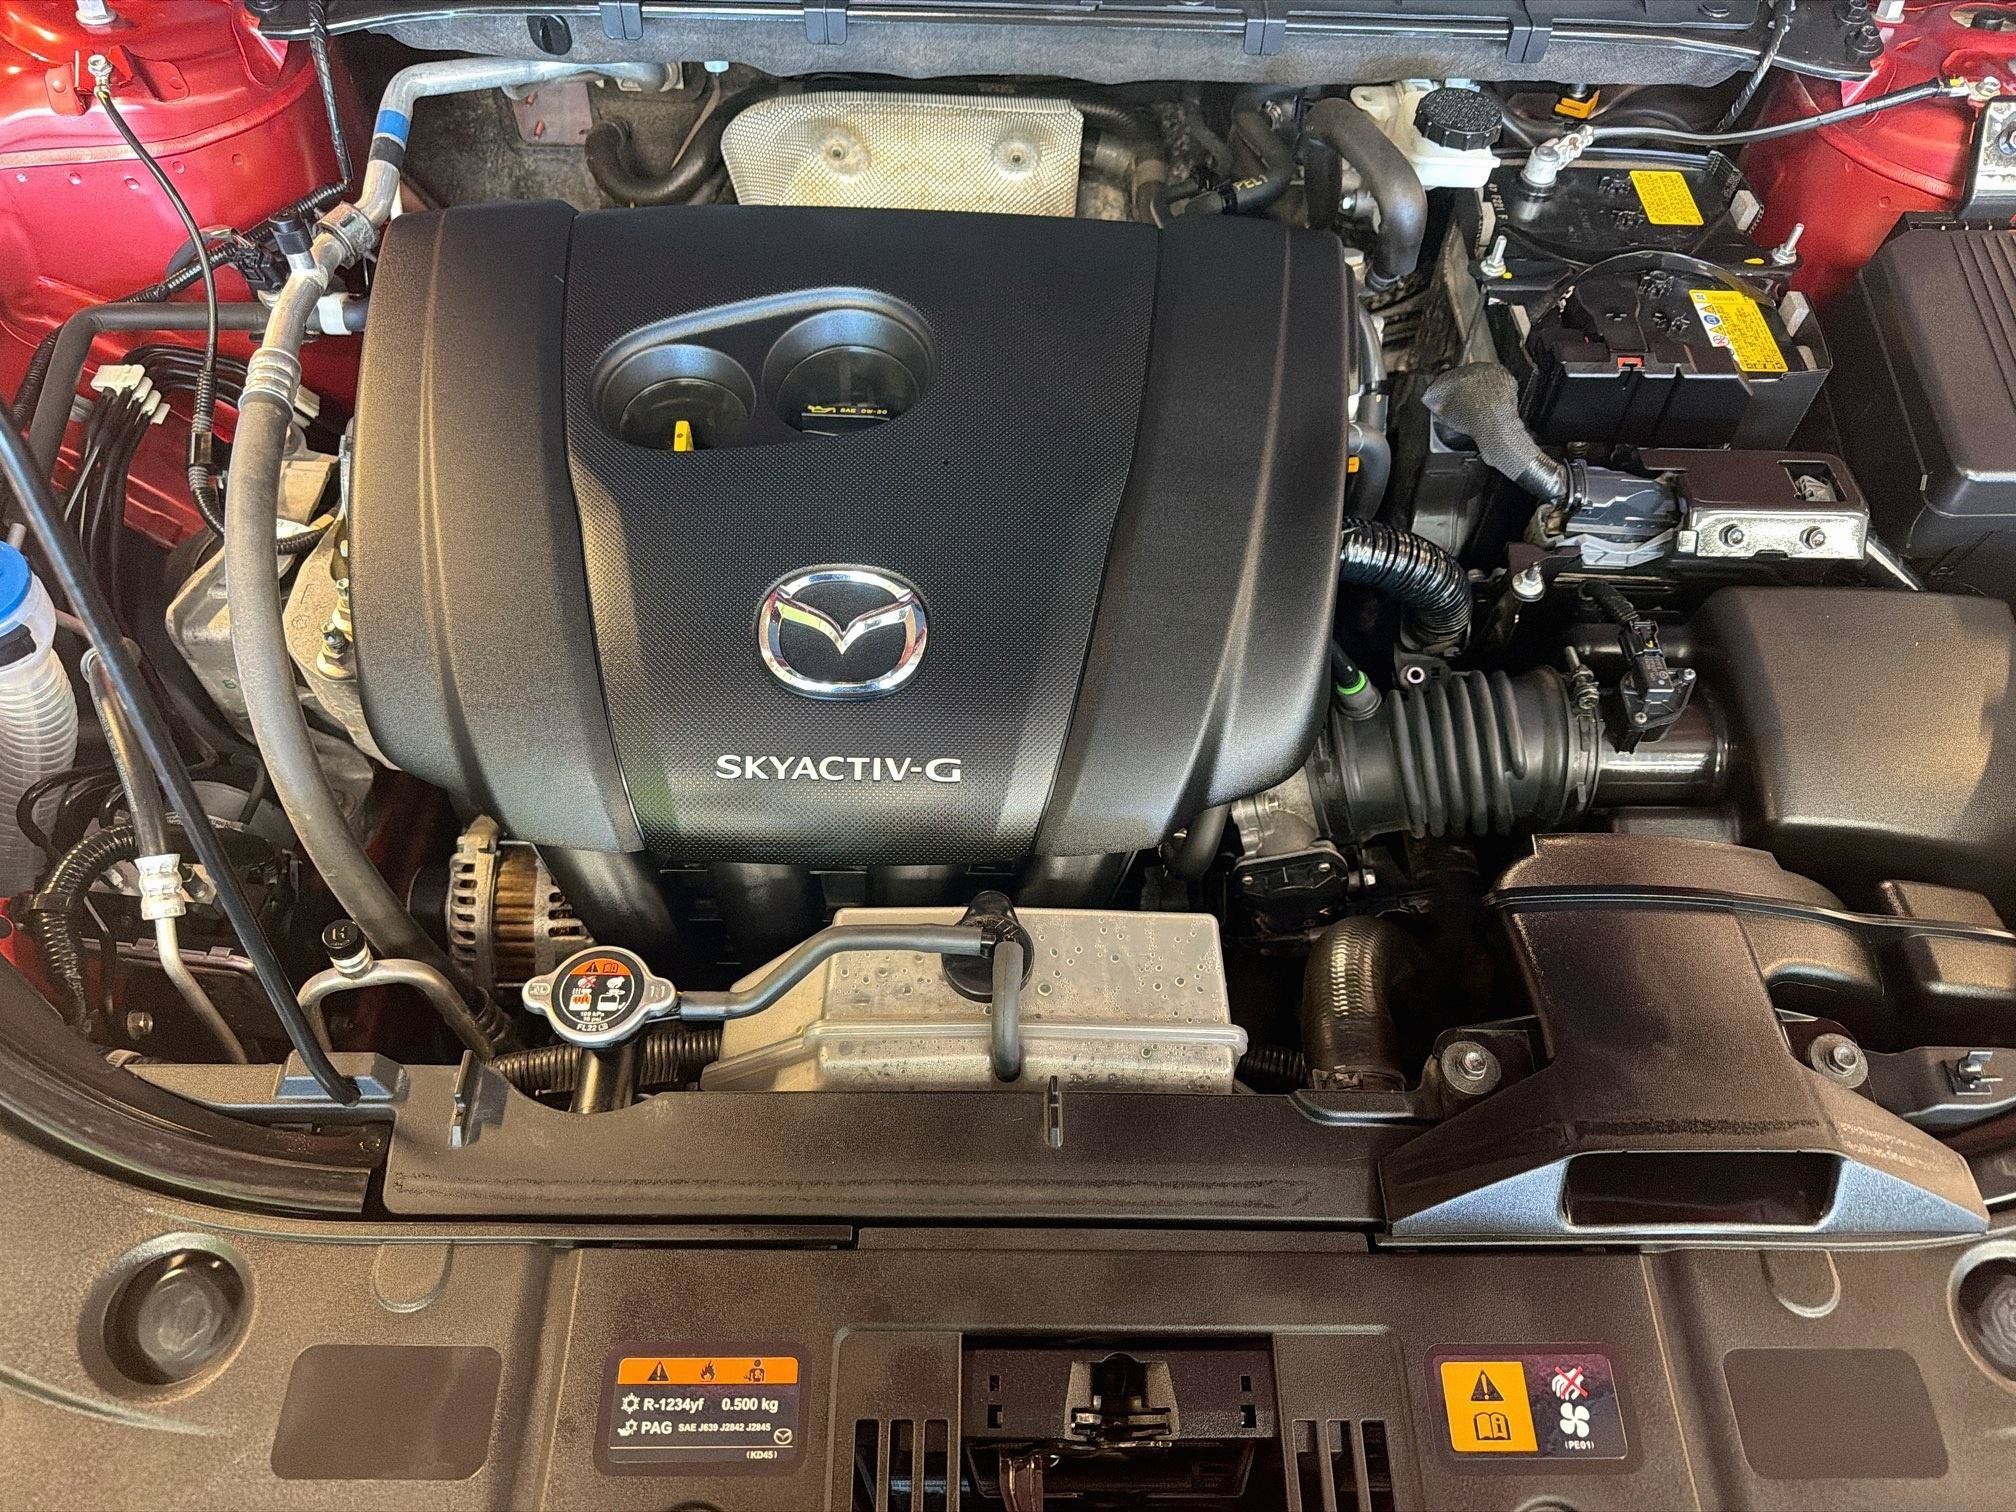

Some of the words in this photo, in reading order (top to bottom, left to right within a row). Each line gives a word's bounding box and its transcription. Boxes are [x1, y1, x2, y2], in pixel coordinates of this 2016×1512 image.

[715, 754, 962, 783] SKYACTIV-G
[576, 1023, 597, 1031] FL22
[643, 1398, 705, 1413] R-1234yf
[721, 1398, 758, 1411] 0.500
[761, 1398, 779, 1413] kg
[641, 1422, 673, 1435] PAG
[678, 1423, 697, 1432] SAE
[698, 1423, 718, 1432] J639
